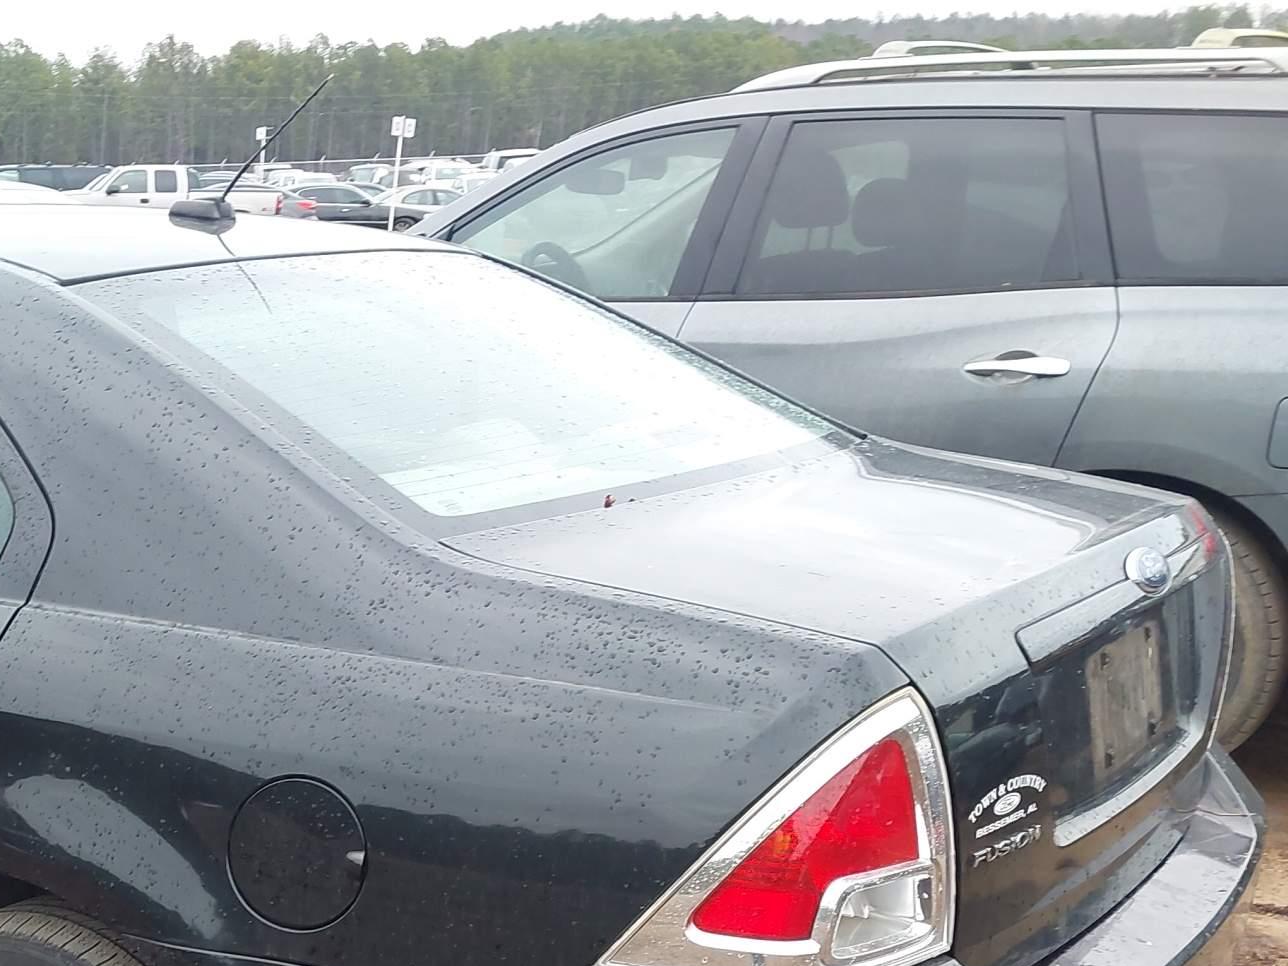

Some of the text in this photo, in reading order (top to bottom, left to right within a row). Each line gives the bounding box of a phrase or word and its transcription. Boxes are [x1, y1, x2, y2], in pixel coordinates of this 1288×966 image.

[967, 787, 998, 823] TOWN
[998, 783, 1007, 797] &
[1006, 774, 1048, 792] COUNTRY
[972, 824, 1042, 869] FUSION
